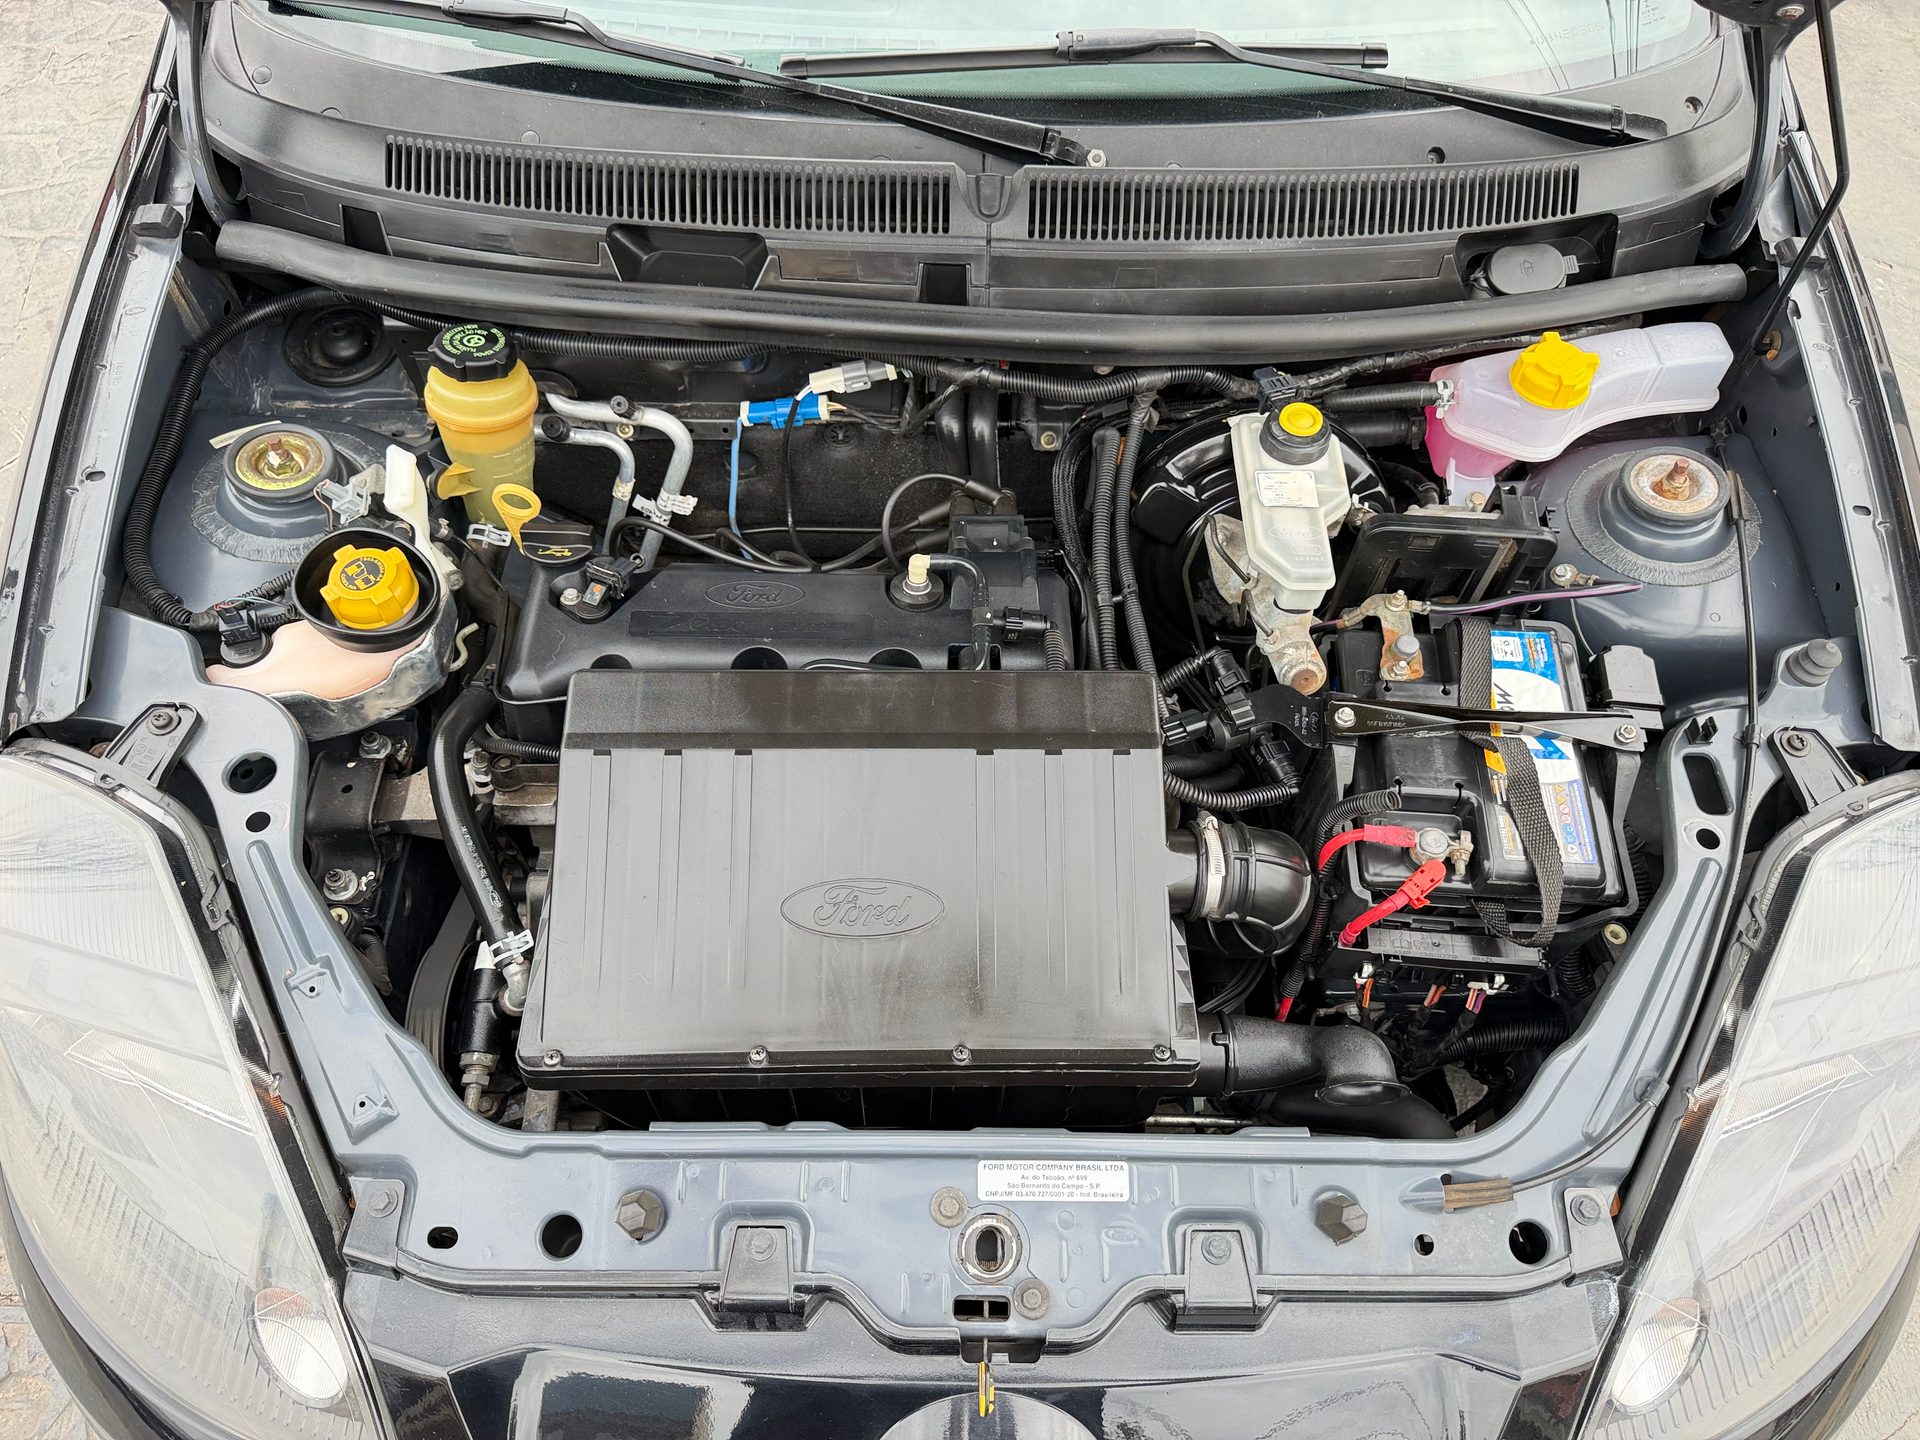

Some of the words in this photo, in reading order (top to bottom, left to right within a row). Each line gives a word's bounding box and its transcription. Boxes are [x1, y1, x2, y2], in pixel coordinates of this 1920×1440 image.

[473, 349, 495, 357] POWER
[726, 584, 784, 604] Ford
[813, 884, 912, 927] Ford
[1075, 1164, 1103, 1172] BRASIL
[1105, 1164, 1124, 1172] LTDA
[1061, 1182, 1084, 1190] Campo
